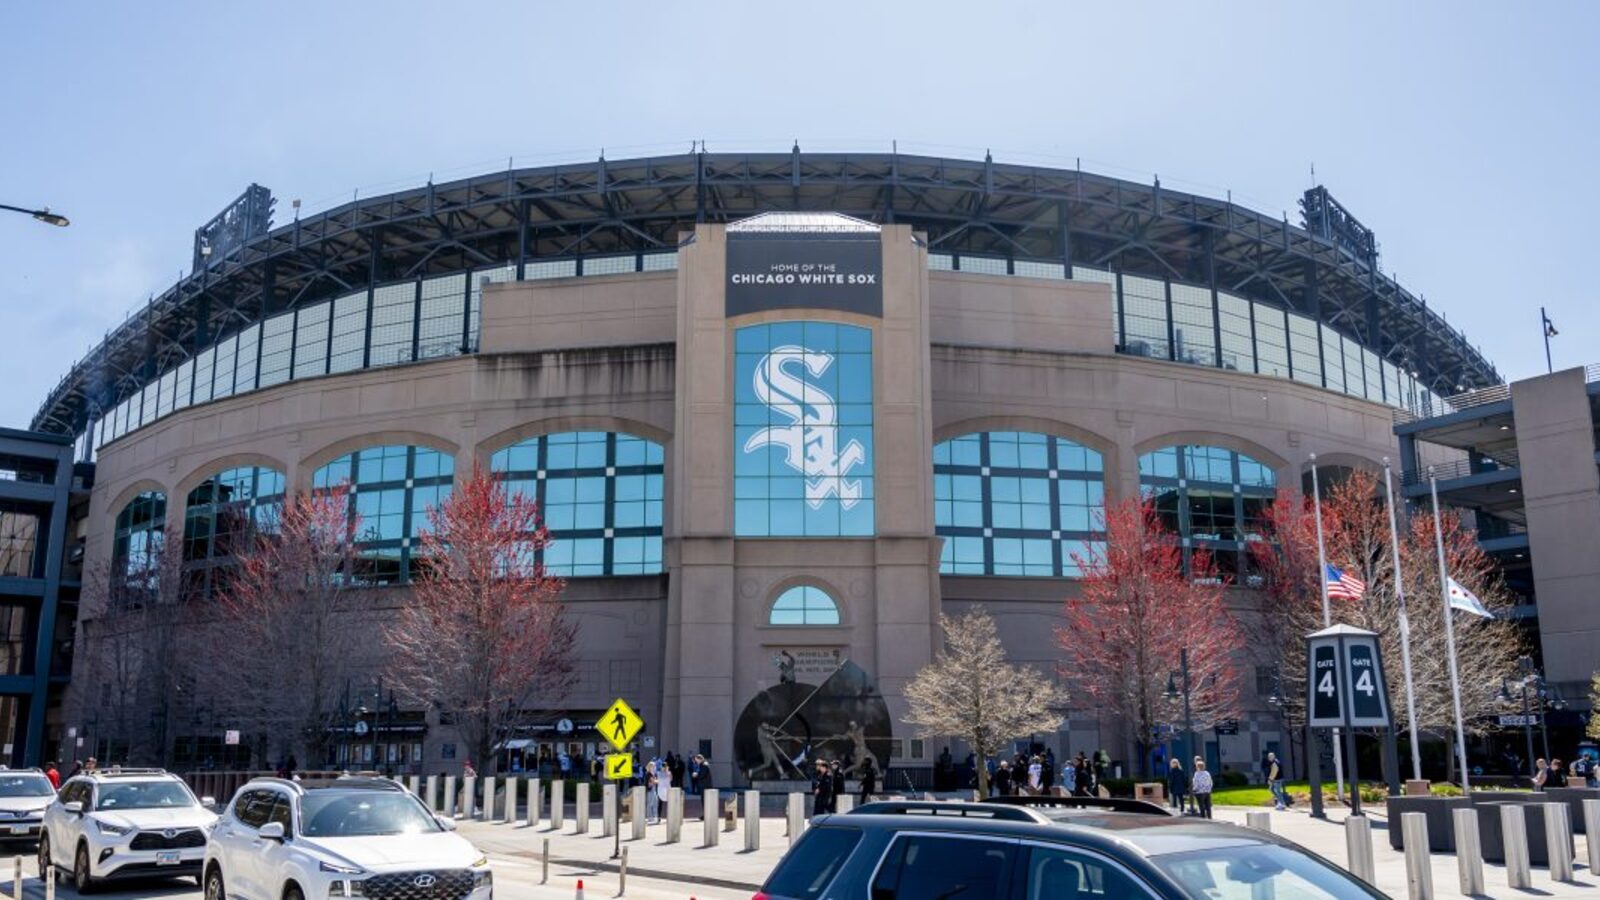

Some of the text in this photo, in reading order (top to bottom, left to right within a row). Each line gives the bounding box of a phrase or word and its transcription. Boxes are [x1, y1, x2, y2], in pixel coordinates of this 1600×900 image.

[771, 264, 836, 272] HOME OF THE
[732, 274, 876, 284] CHICAGO WHITE SOX
[1317, 660, 1334, 668] GATE
[1352, 658, 1371, 666] GATE
[1318, 670, 1335, 697] 4
[1356, 670, 1374, 696] 4
